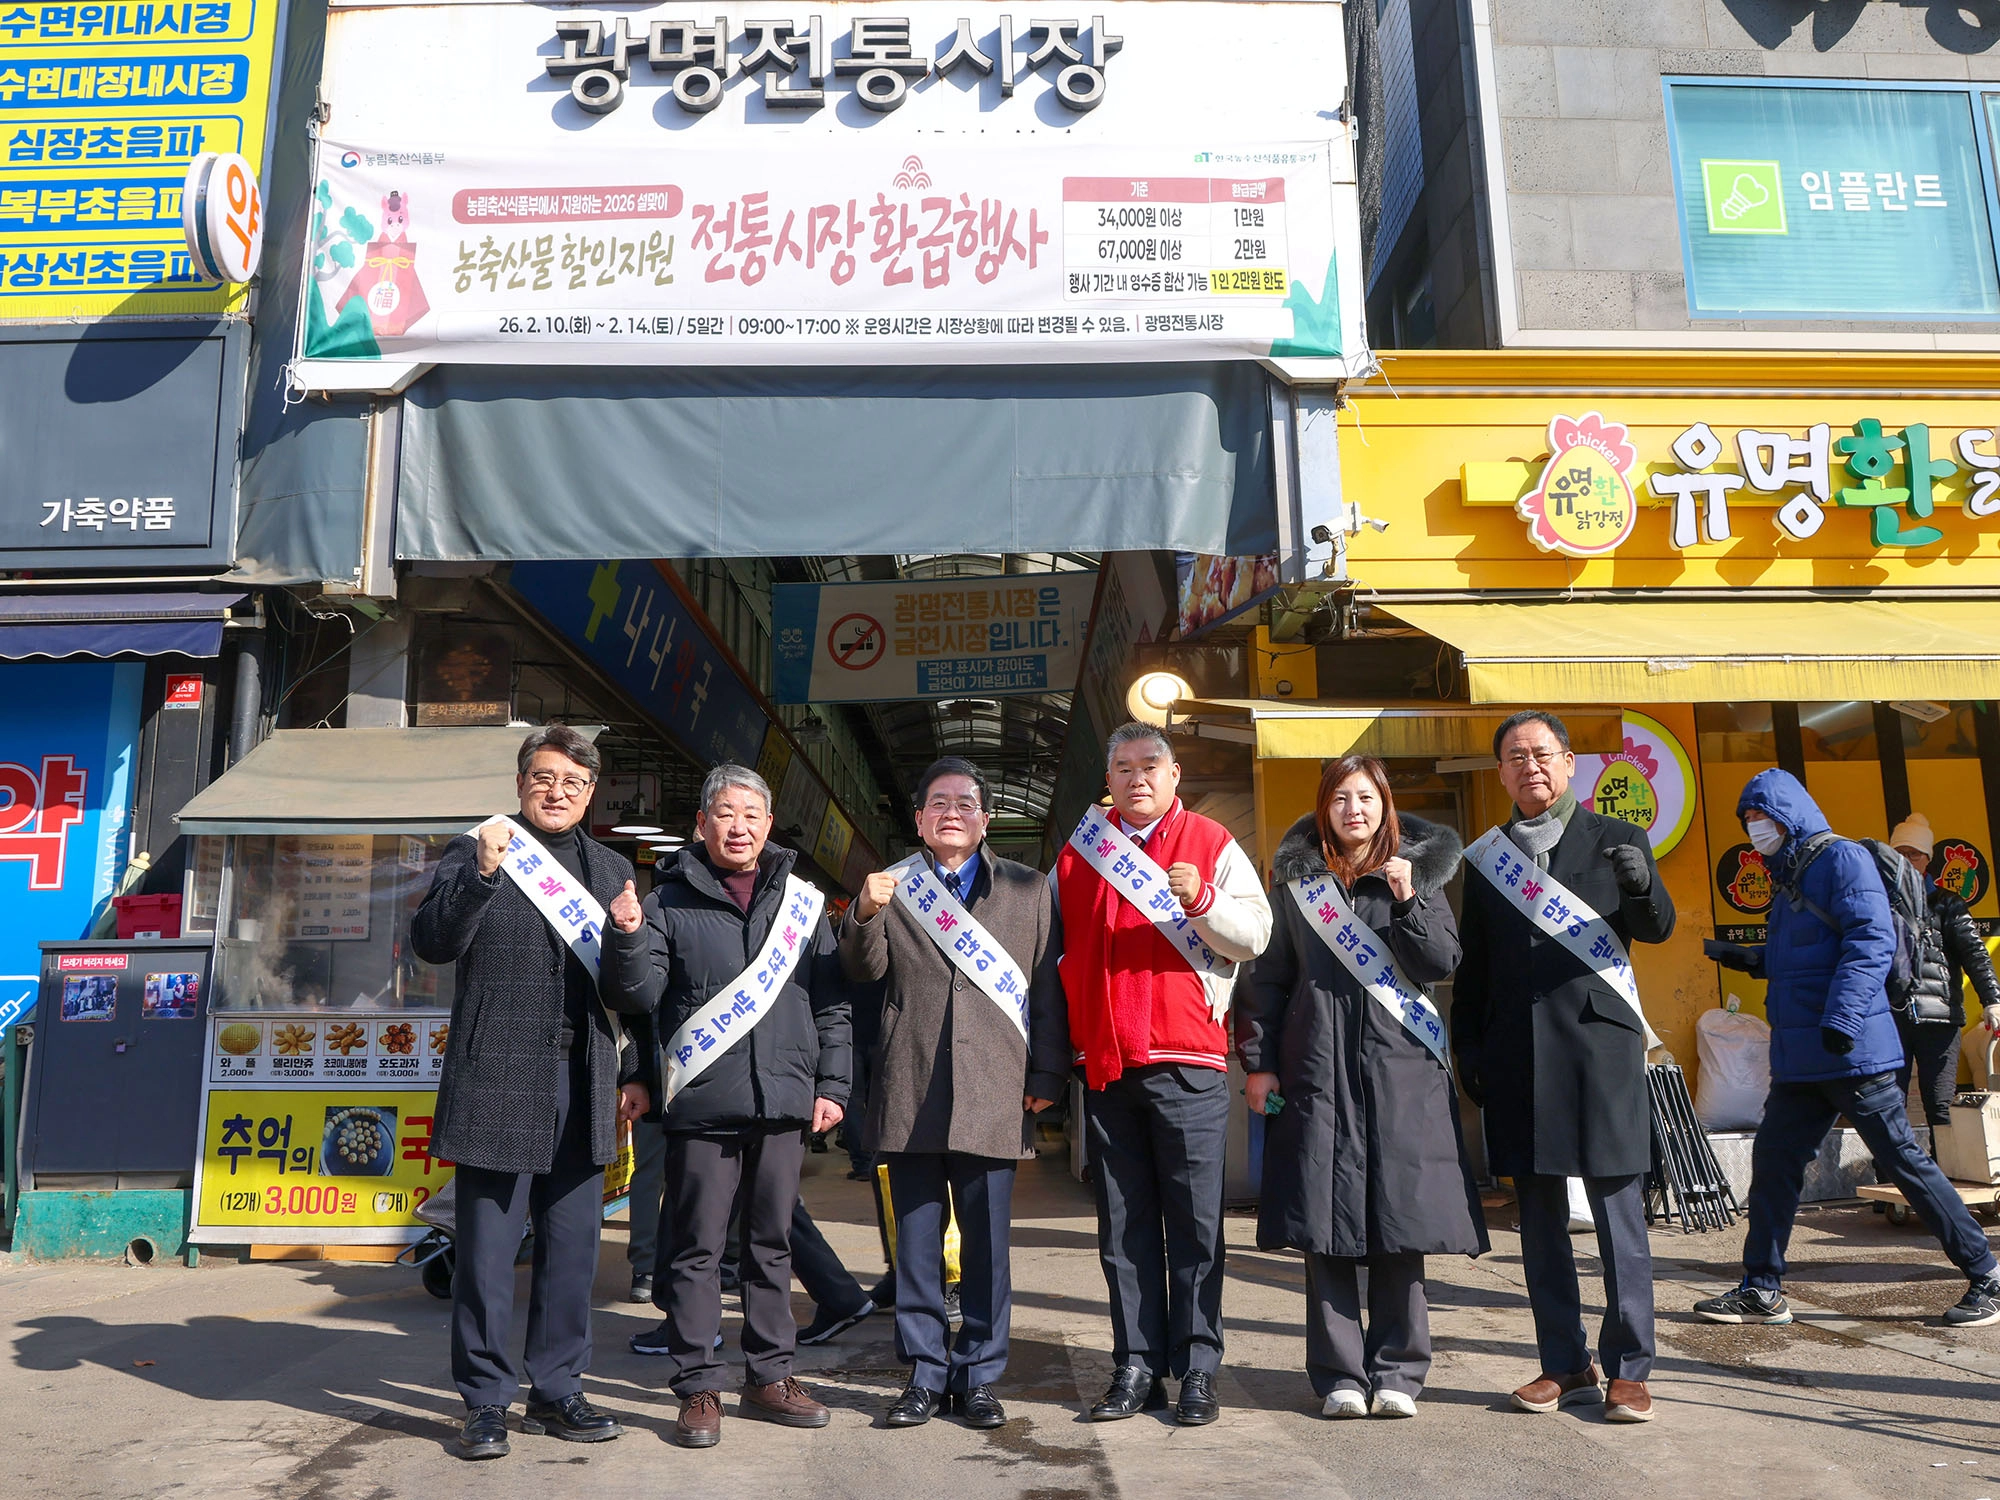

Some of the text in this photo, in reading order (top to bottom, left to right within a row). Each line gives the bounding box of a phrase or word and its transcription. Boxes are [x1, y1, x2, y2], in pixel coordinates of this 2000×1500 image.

[1, 2, 231, 38] 수면위내시경
[0, 63, 236, 100] 수면대장내시경
[545, 14, 1124, 114] 광명전통시장
[8, 125, 205, 161] 심장초음파
[365, 152, 446, 167] 농림축산식품부
[467, 191, 669, 217] 농림축산식품부에서 지원하는 2026 설맞이
[1131, 181, 1148, 198] 기준
[1231, 182, 1267, 199] 환급금액
[1800, 170, 1949, 212] 임플란트
[226, 163, 260, 273] 약
[1098, 207, 1183, 230] 34,000원 이상
[1234, 208, 1264, 228] 1만원
[691, 190, 1049, 289] 전통시장 환급행사
[1098, 239, 1183, 263] 67,000원 이상
[1234, 239, 1266, 260] 2만원
[453, 230, 675, 293] 농축산물 할인지원
[1069, 272, 1285, 294] 행사 기간 내 영수증 합산 가능 1인 2만원 한도
[499, 317, 523, 333] 26.
[526, 317, 541, 333] 2.
[545, 316, 592, 334] 10.(화)
[608, 317, 623, 333] 2.
[628, 317, 673, 334] 14.(토)
[687, 317, 724, 335] 5일간
[738, 318, 841, 334] 09:00~17:00
[864, 317, 932, 335] 운영시간은
[936, 317, 1003, 334] 시장상황에
[1007, 318, 1034, 334] 따라
[1038, 315, 1078, 334] 변경될
[1082, 317, 1095, 333] 수
[1099, 316, 1130, 333] 있음.
[1144, 314, 1224, 331] 광명전통시장
[1565, 430, 1620, 467] Chicken
[1548, 467, 1621, 516] 유명환
[40, 497, 175, 532] 가축약품
[1575, 510, 1623, 530] 닭강정
[894, 587, 1061, 623] 광명전통시장은
[894, 620, 1069, 657] 금연시장입니다.
[928, 675, 966, 691] 금연이
[956, 660, 994, 674] 표시가
[997, 657, 1036, 673] 없어도
[1597, 776, 1650, 814] 유명환
[1096, 838, 1117, 858] 복
[1112, 852, 1153, 891] 많이
[538, 876, 566, 897] 복
[559, 898, 602, 943] 많이
[1494, 851, 1523, 887] 새해
[1521, 879, 1544, 901] 복
[1542, 894, 1590, 938] 많이
[906, 873, 939, 913] 새해
[935, 909, 959, 932] 복
[954, 929, 997, 972] 많이
[62, 958, 125, 967] 쓰레기 버리지 마세요
[675, 891, 813, 1067] 새해 복 많이 받으세요
[1318, 901, 1340, 925] 복
[1335, 922, 1378, 967] 많이
[1375, 964, 1440, 1041] 받으세요
[273, 1058, 314, 1068] 델리만쥬
[323, 1058, 367, 1068] 초코미니붕어빵
[378, 1058, 419, 1068] 호도과자
[220, 1191, 261, 1212] (12개)
